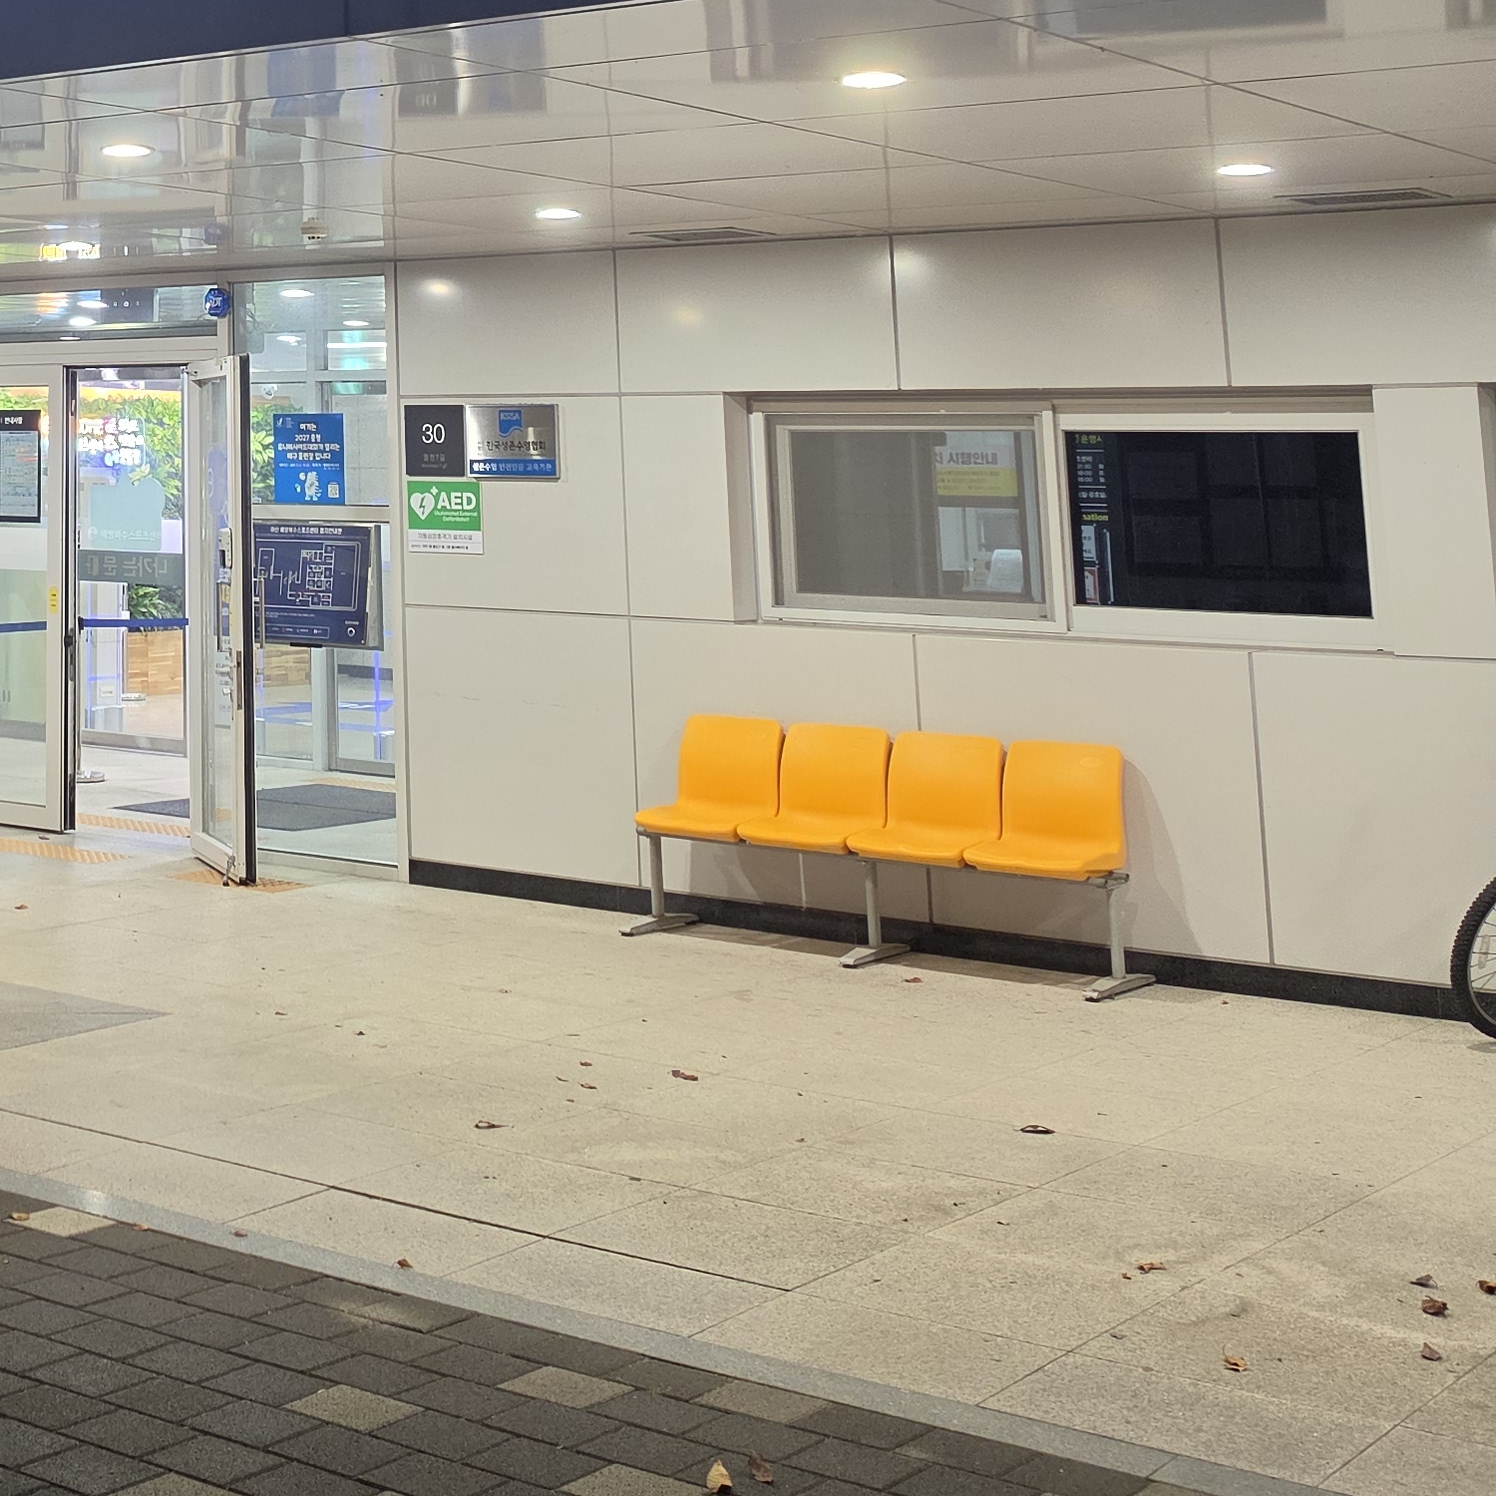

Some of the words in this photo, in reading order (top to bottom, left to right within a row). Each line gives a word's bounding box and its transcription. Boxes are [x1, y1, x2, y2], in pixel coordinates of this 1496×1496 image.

[500, 412, 520, 420] KSSA
[294, 434, 310, 442] 2027
[421, 423, 446, 444] 30
[486, 440, 546, 452] 한국생존수영협회
[947, 451, 998, 465] 시행안내
[437, 492, 476, 510] AED
